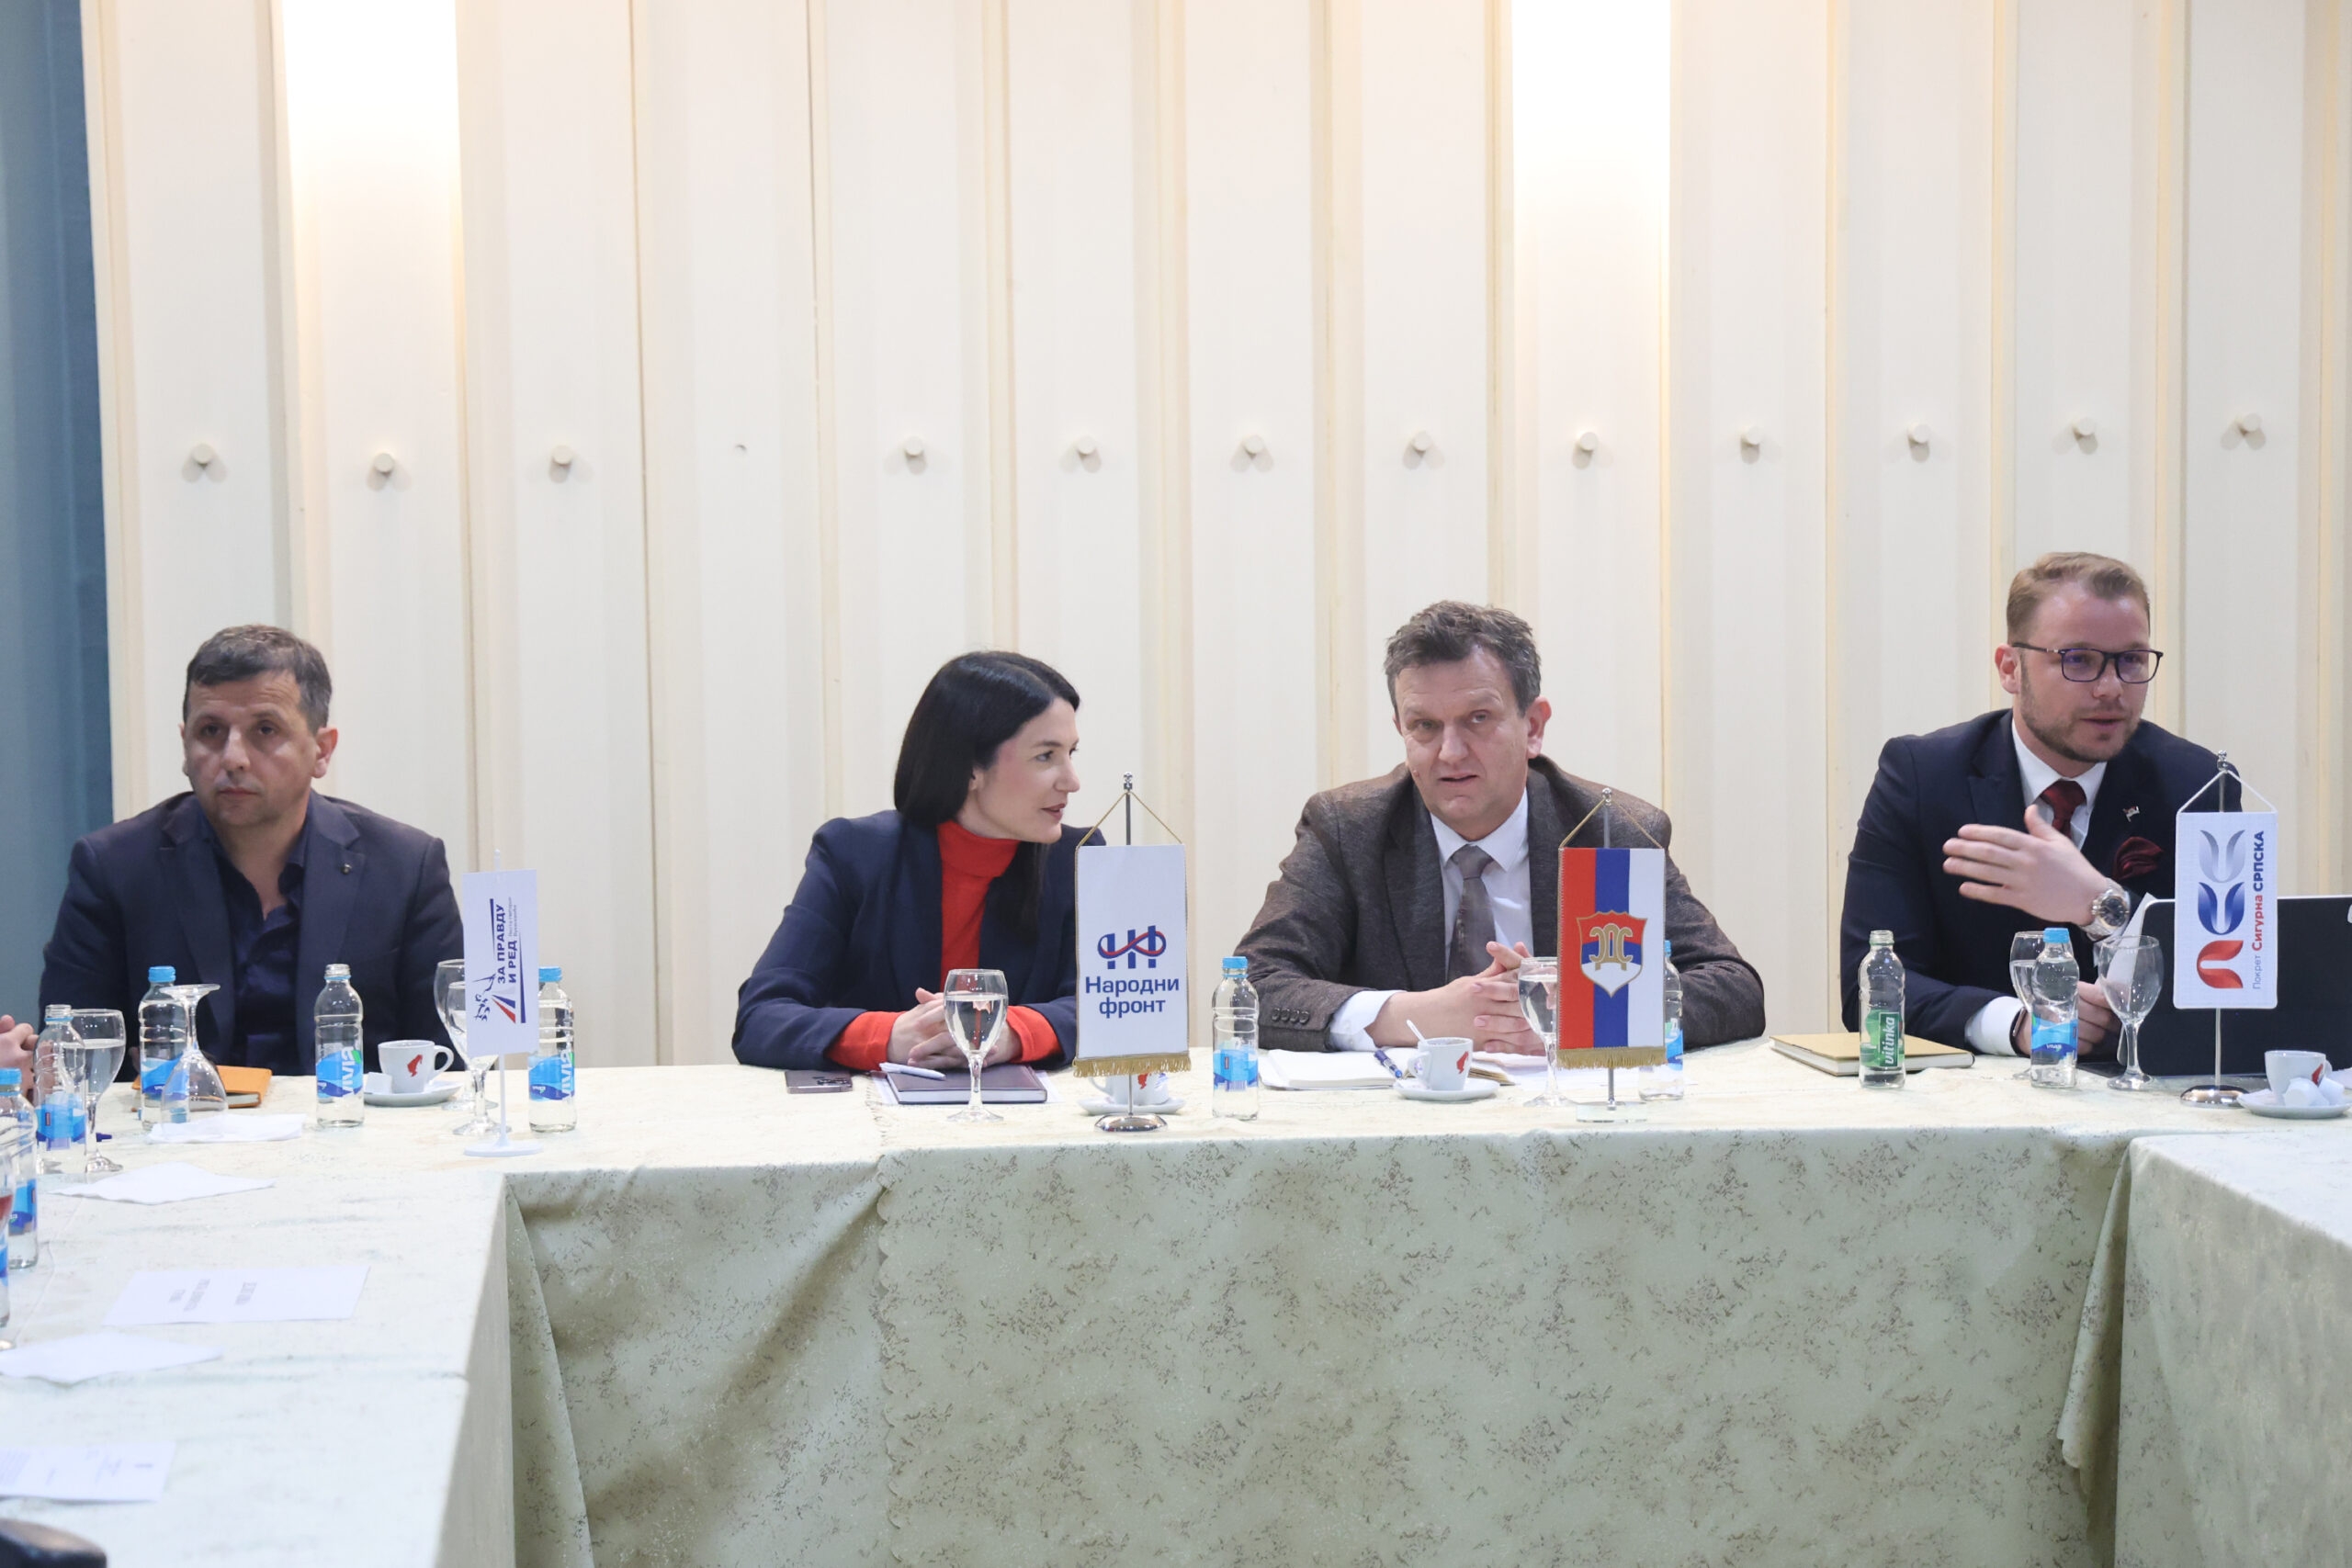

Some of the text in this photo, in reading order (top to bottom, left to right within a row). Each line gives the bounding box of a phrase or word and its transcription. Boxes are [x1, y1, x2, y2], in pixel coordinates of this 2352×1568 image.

[2252, 830, 2264, 989] Покрет Сигурна СРПСКА
[496, 904, 506, 984] ЗА ПРАВДУ
[507, 940, 517, 984] И РЕД
[1085, 976, 1180, 998] Народни
[1099, 997, 1166, 1019] фронт
